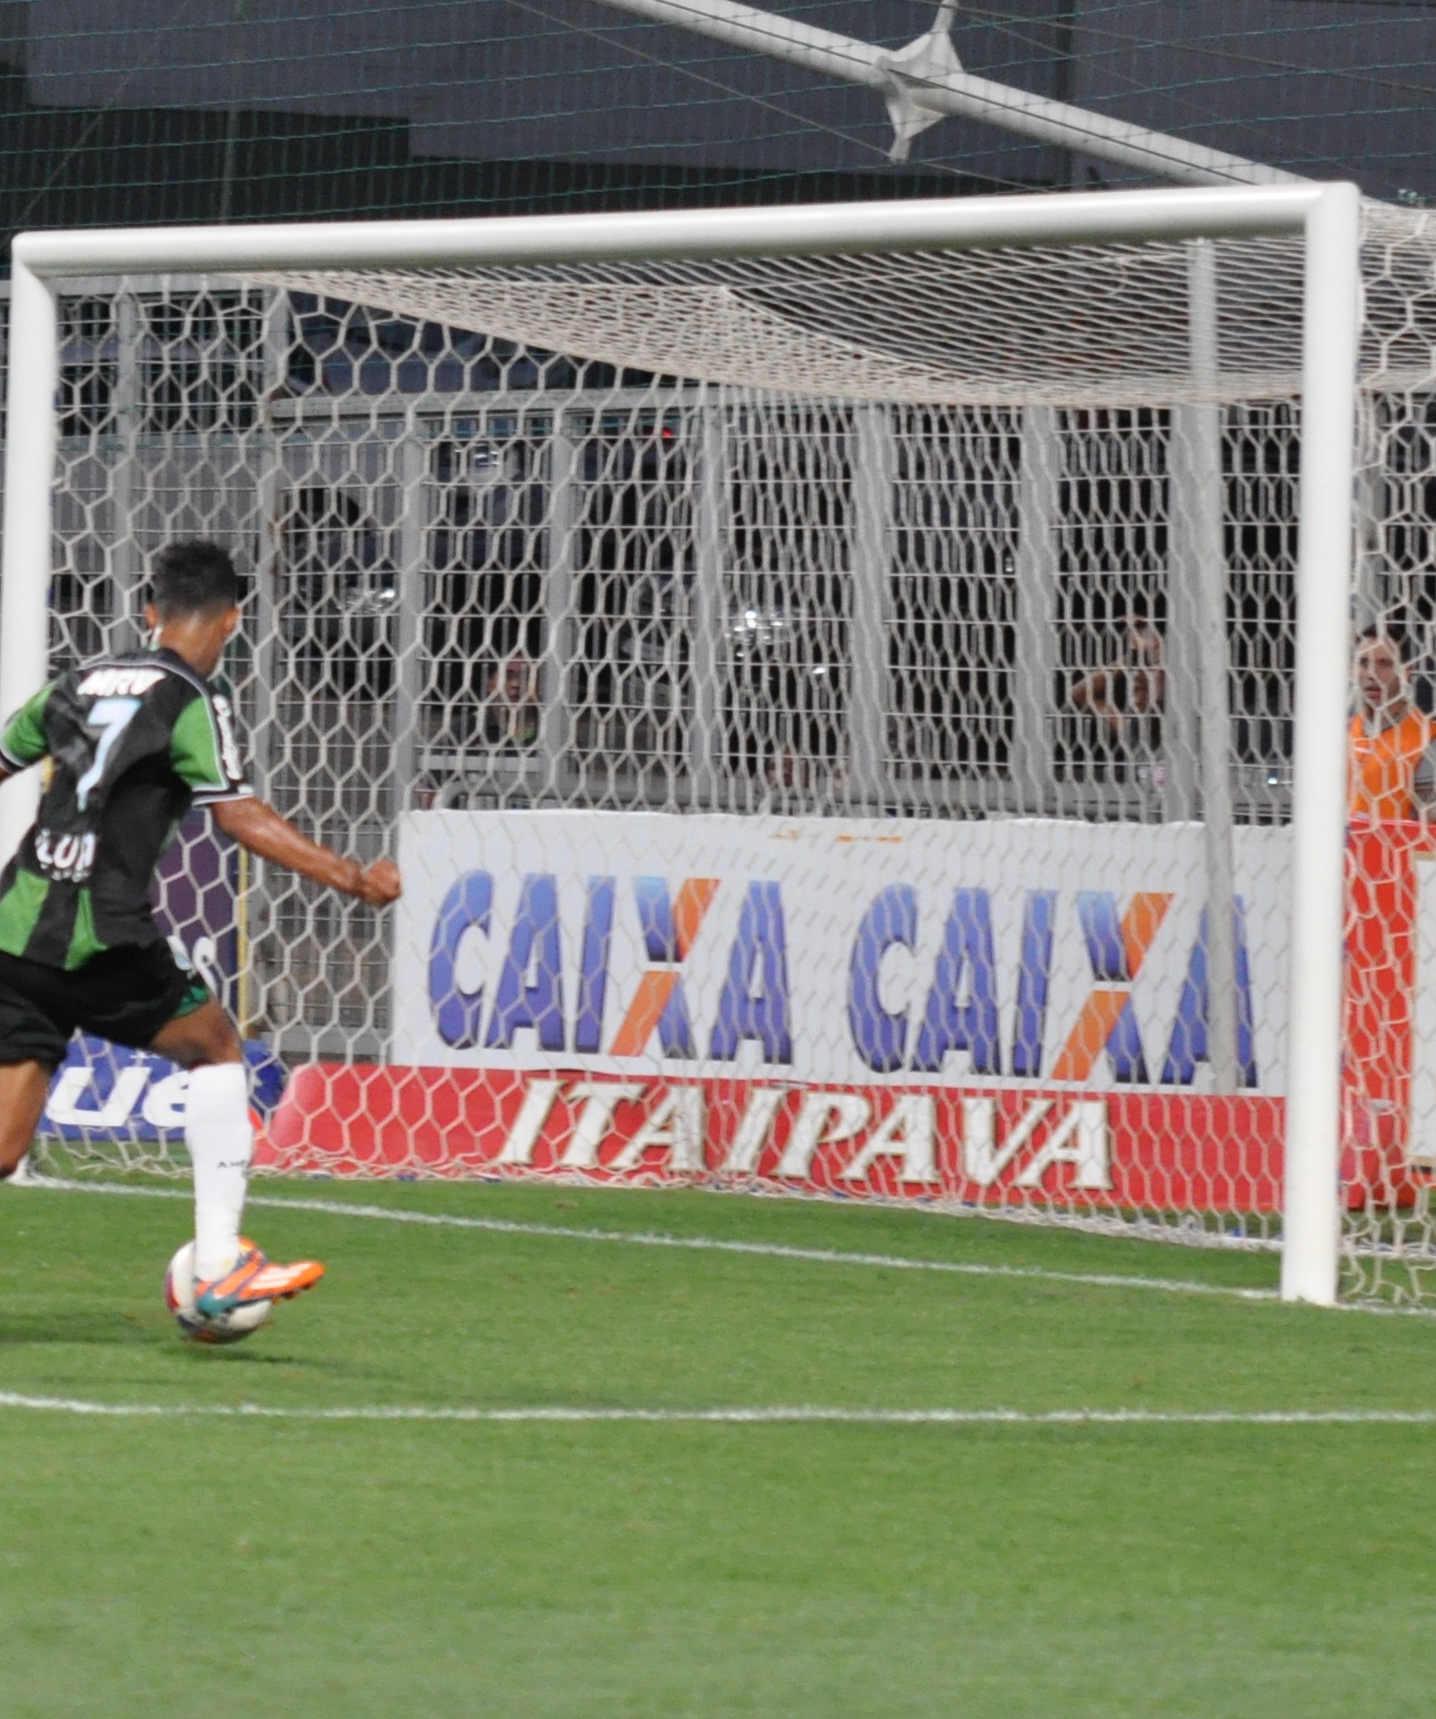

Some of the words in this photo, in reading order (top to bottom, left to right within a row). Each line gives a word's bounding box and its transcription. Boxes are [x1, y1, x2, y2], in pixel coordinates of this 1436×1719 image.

[76, 698, 143, 812] 7
[428, 869, 793, 1065] CAIXA
[848, 882, 1258, 1088] CAIXA
[498, 1078, 1114, 1190] ITAIPAVA
